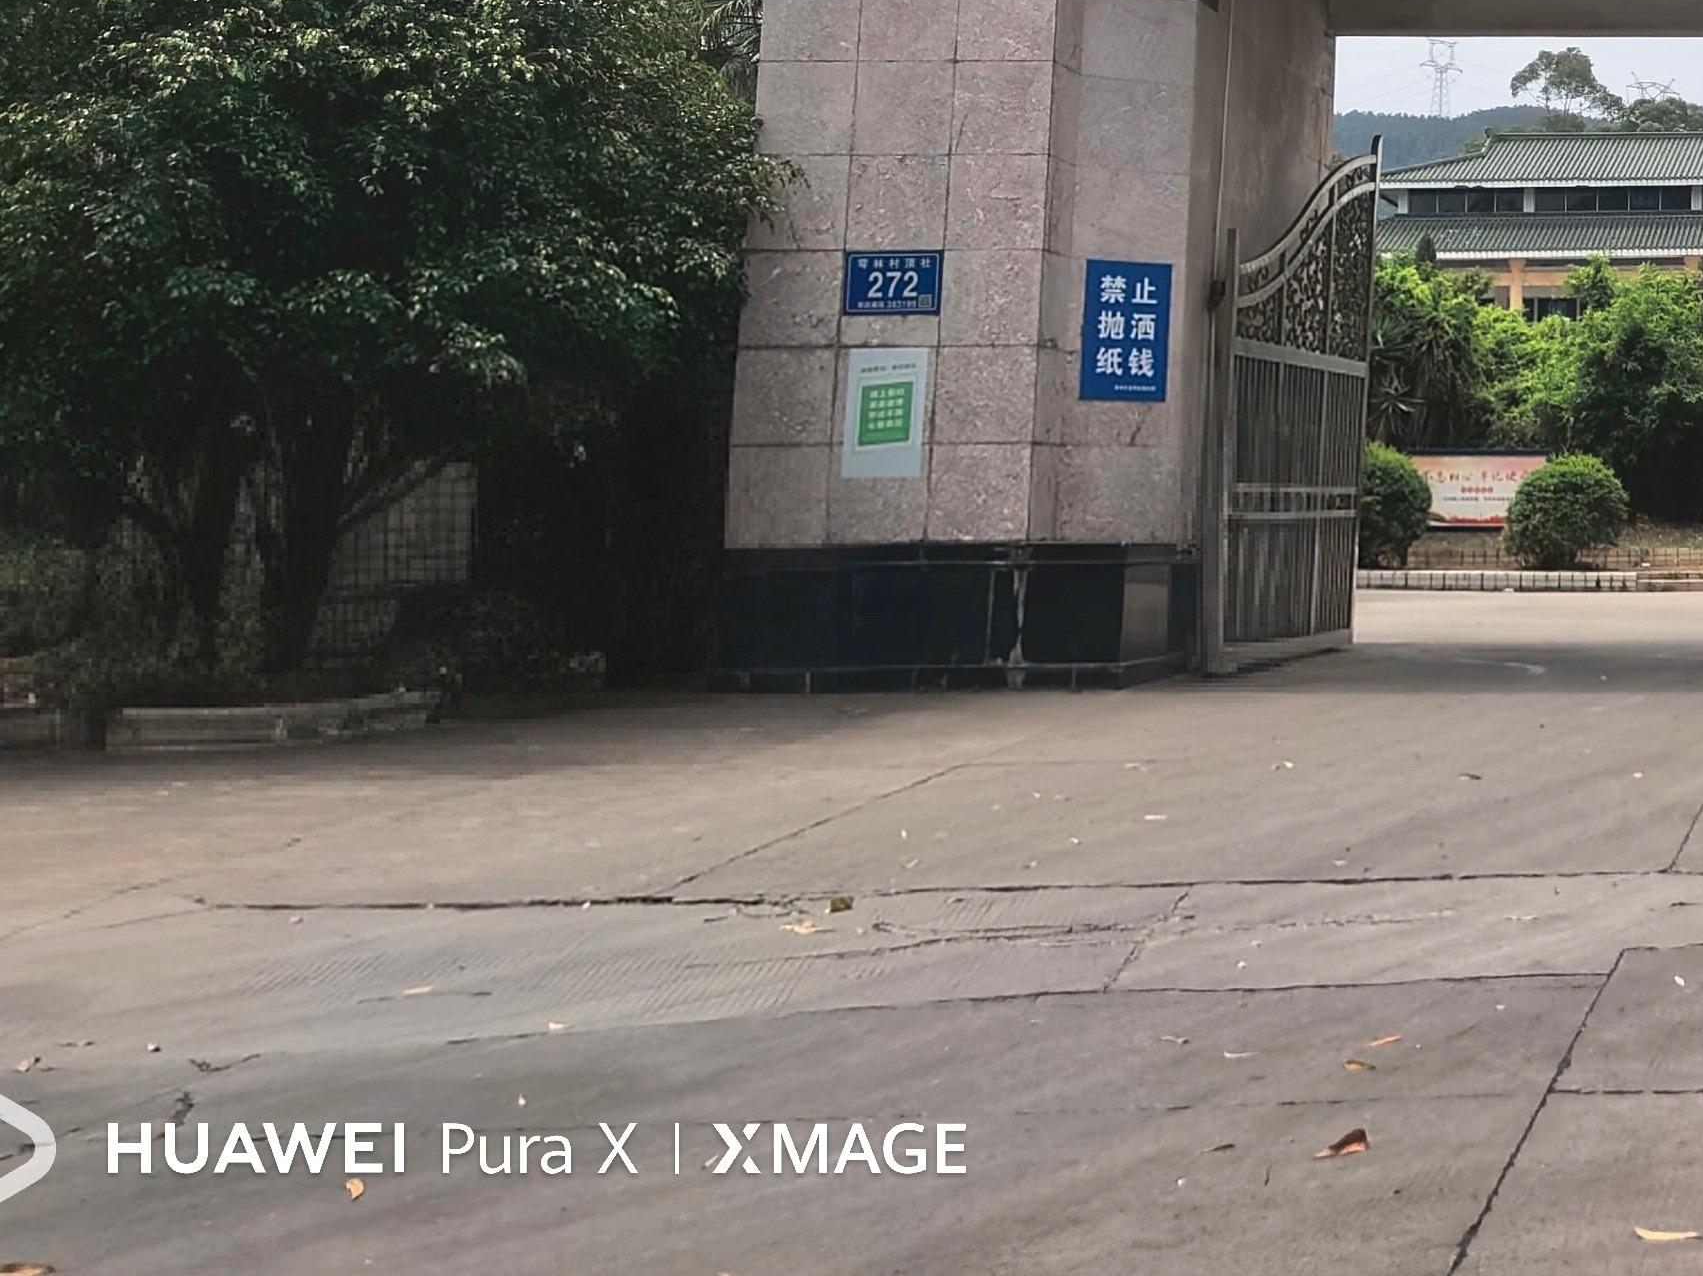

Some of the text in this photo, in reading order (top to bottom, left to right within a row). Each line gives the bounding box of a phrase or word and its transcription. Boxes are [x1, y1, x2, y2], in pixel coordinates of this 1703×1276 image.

[867, 271, 919, 299] 272
[1099, 275, 1158, 305] 禁止
[1098, 312, 1156, 341] 抛洒
[1096, 347, 1155, 377] 纸钱
